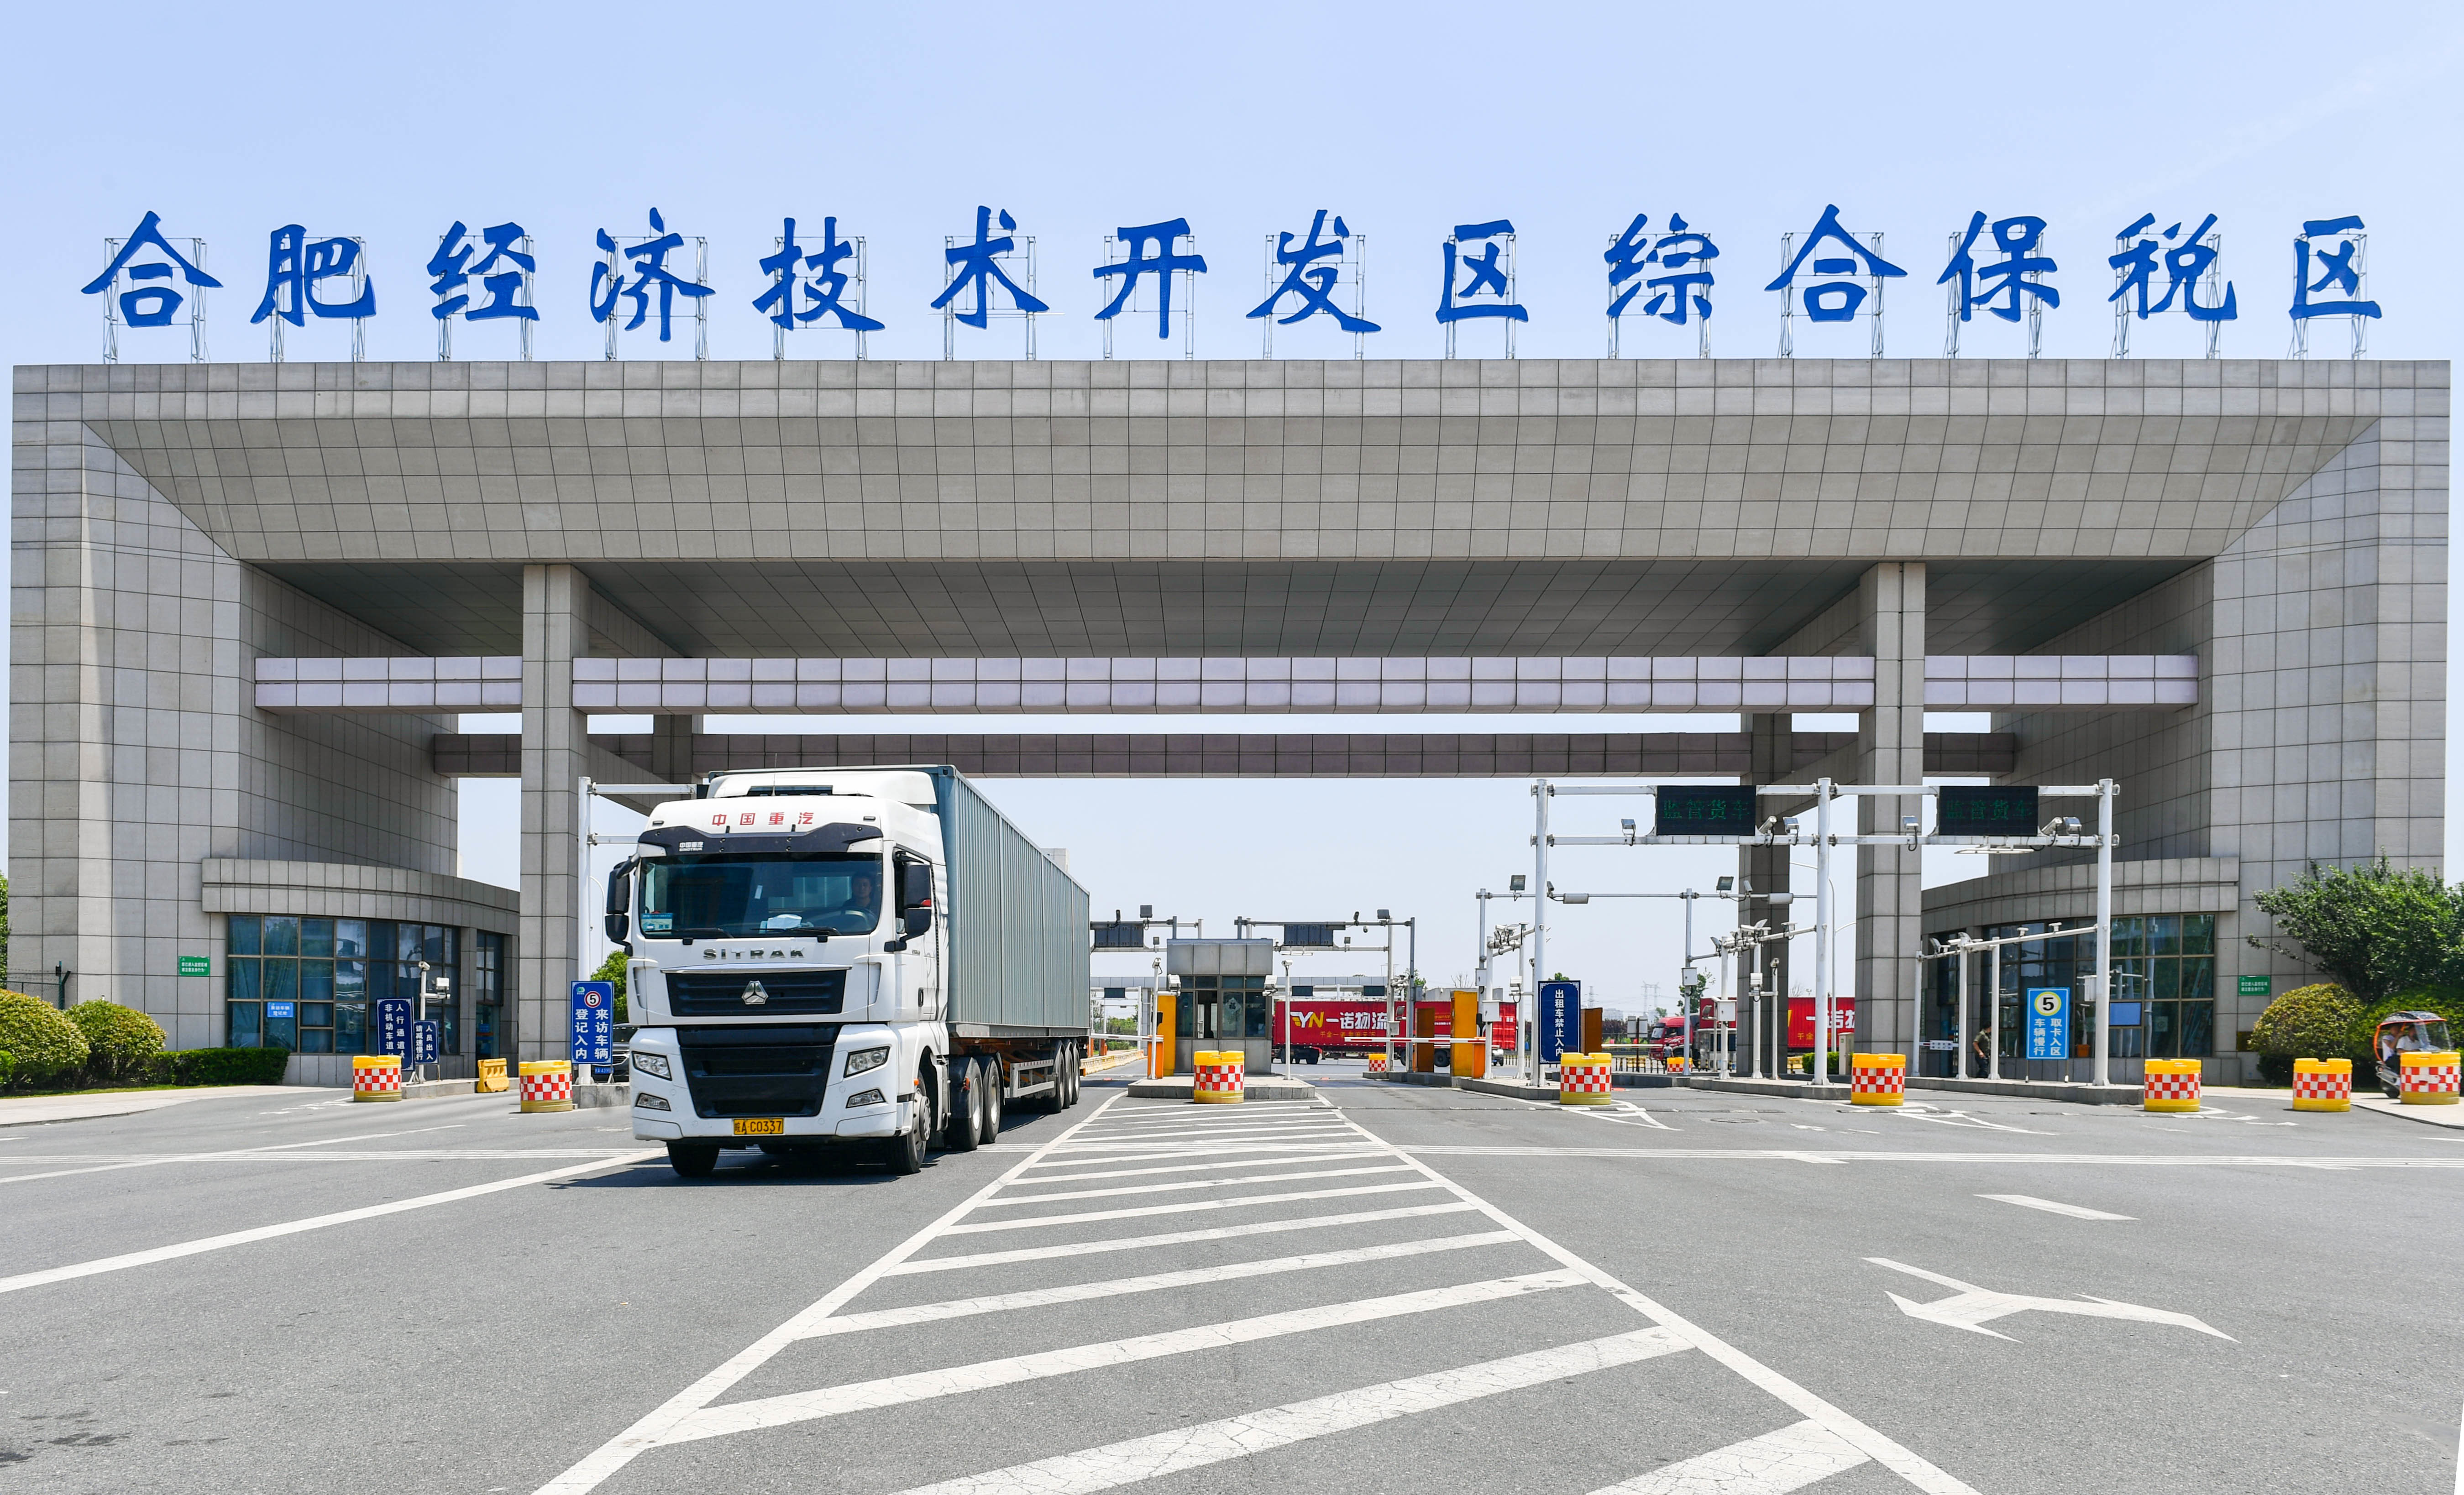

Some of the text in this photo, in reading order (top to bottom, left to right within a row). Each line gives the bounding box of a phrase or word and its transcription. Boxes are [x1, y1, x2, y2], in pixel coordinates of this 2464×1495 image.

[81, 205, 2381, 341] 合肥经济技术开发区综合保税区
[712, 812, 814, 826] 中国重汽
[1663, 800, 1750, 820] 监管货车
[703, 947, 805, 960] SITRAK
[590, 995, 596, 1004] 5
[2043, 997, 2054, 1011] 5
[384, 1004, 393, 1050] 非机动车道
[396, 1004, 405, 1049] 人行通道
[575, 1009, 588, 1059] 登记入内
[595, 1009, 608, 1059] 来访车辆
[1326, 1012, 1387, 1030] 一诺物流
[1555, 989, 1564, 1056] 出租车禁止入内
[2034, 1018, 2046, 1056] 车辆慢行
[2050, 1018, 2062, 1056] 取卡入区
